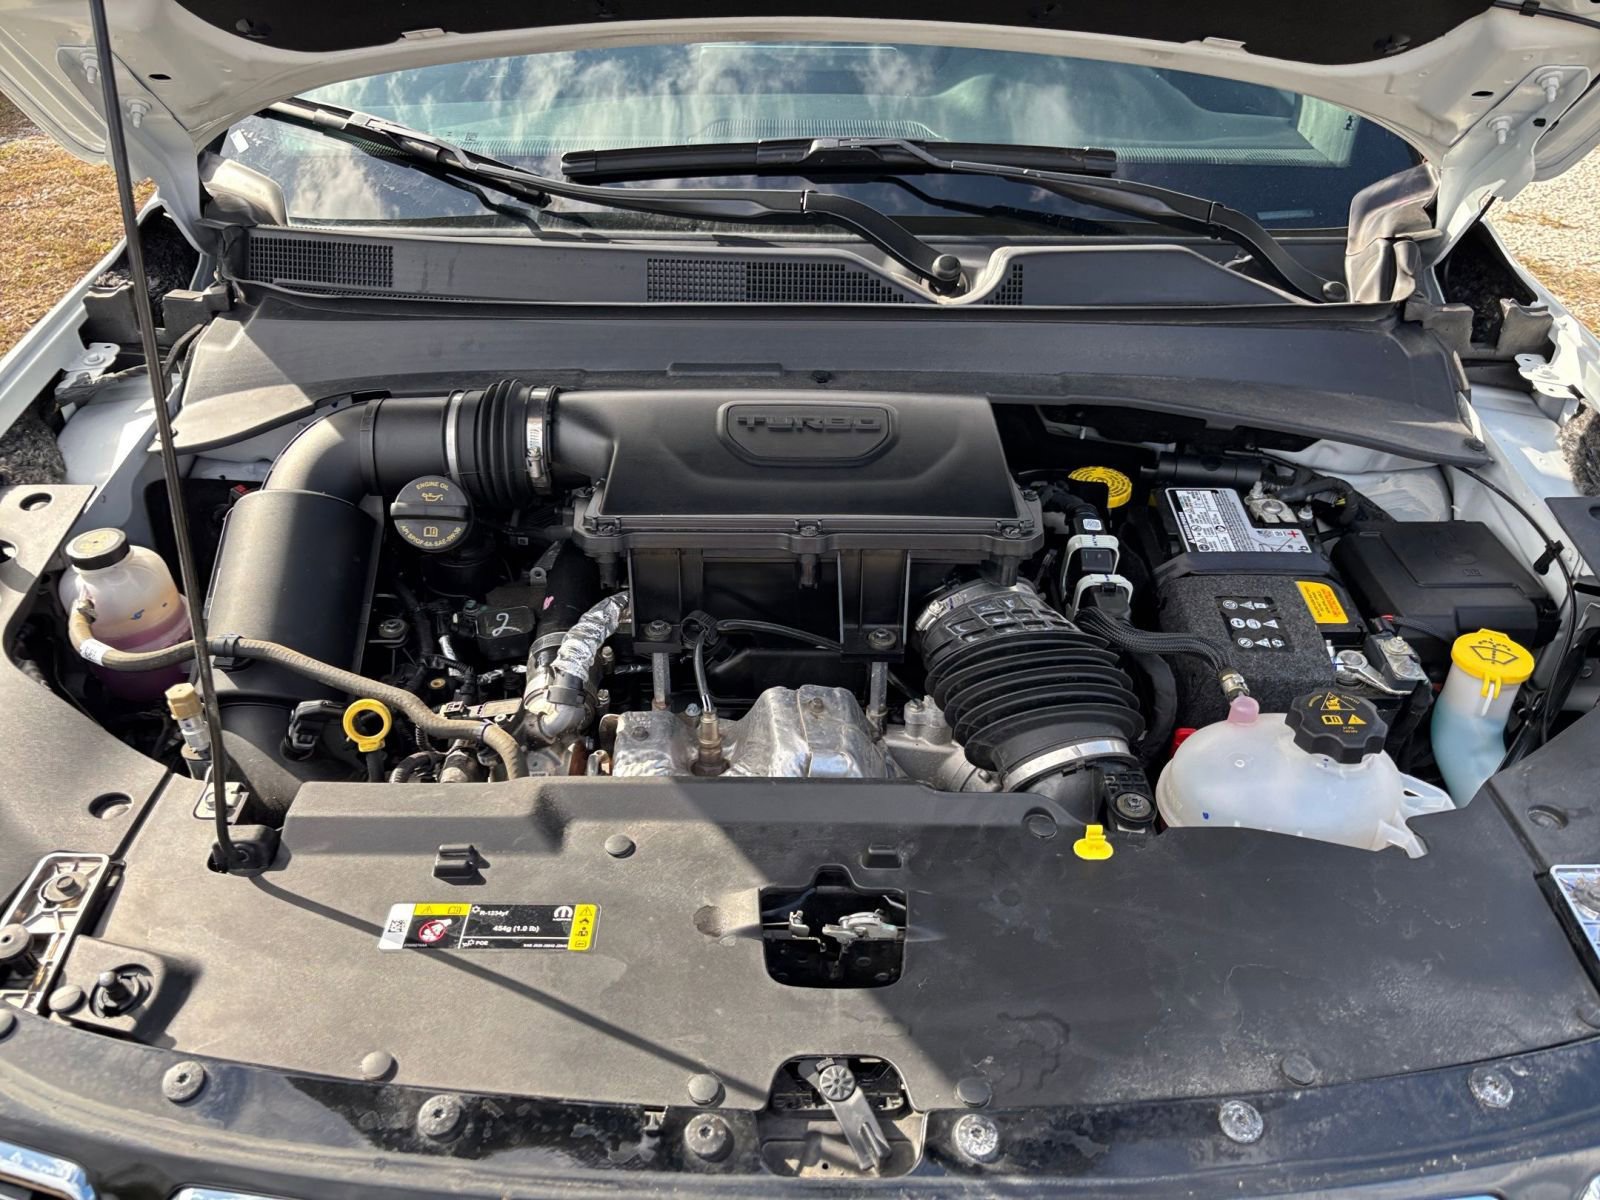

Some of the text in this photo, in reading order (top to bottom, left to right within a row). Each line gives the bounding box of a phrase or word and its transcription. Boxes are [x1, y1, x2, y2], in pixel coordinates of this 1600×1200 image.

[736, 416, 881, 433] TURBO
[415, 481, 449, 491] ENGINE OIL
[491, 612, 523, 637] 2
[492, 925, 540, 933] 454g (1.0 lb)
